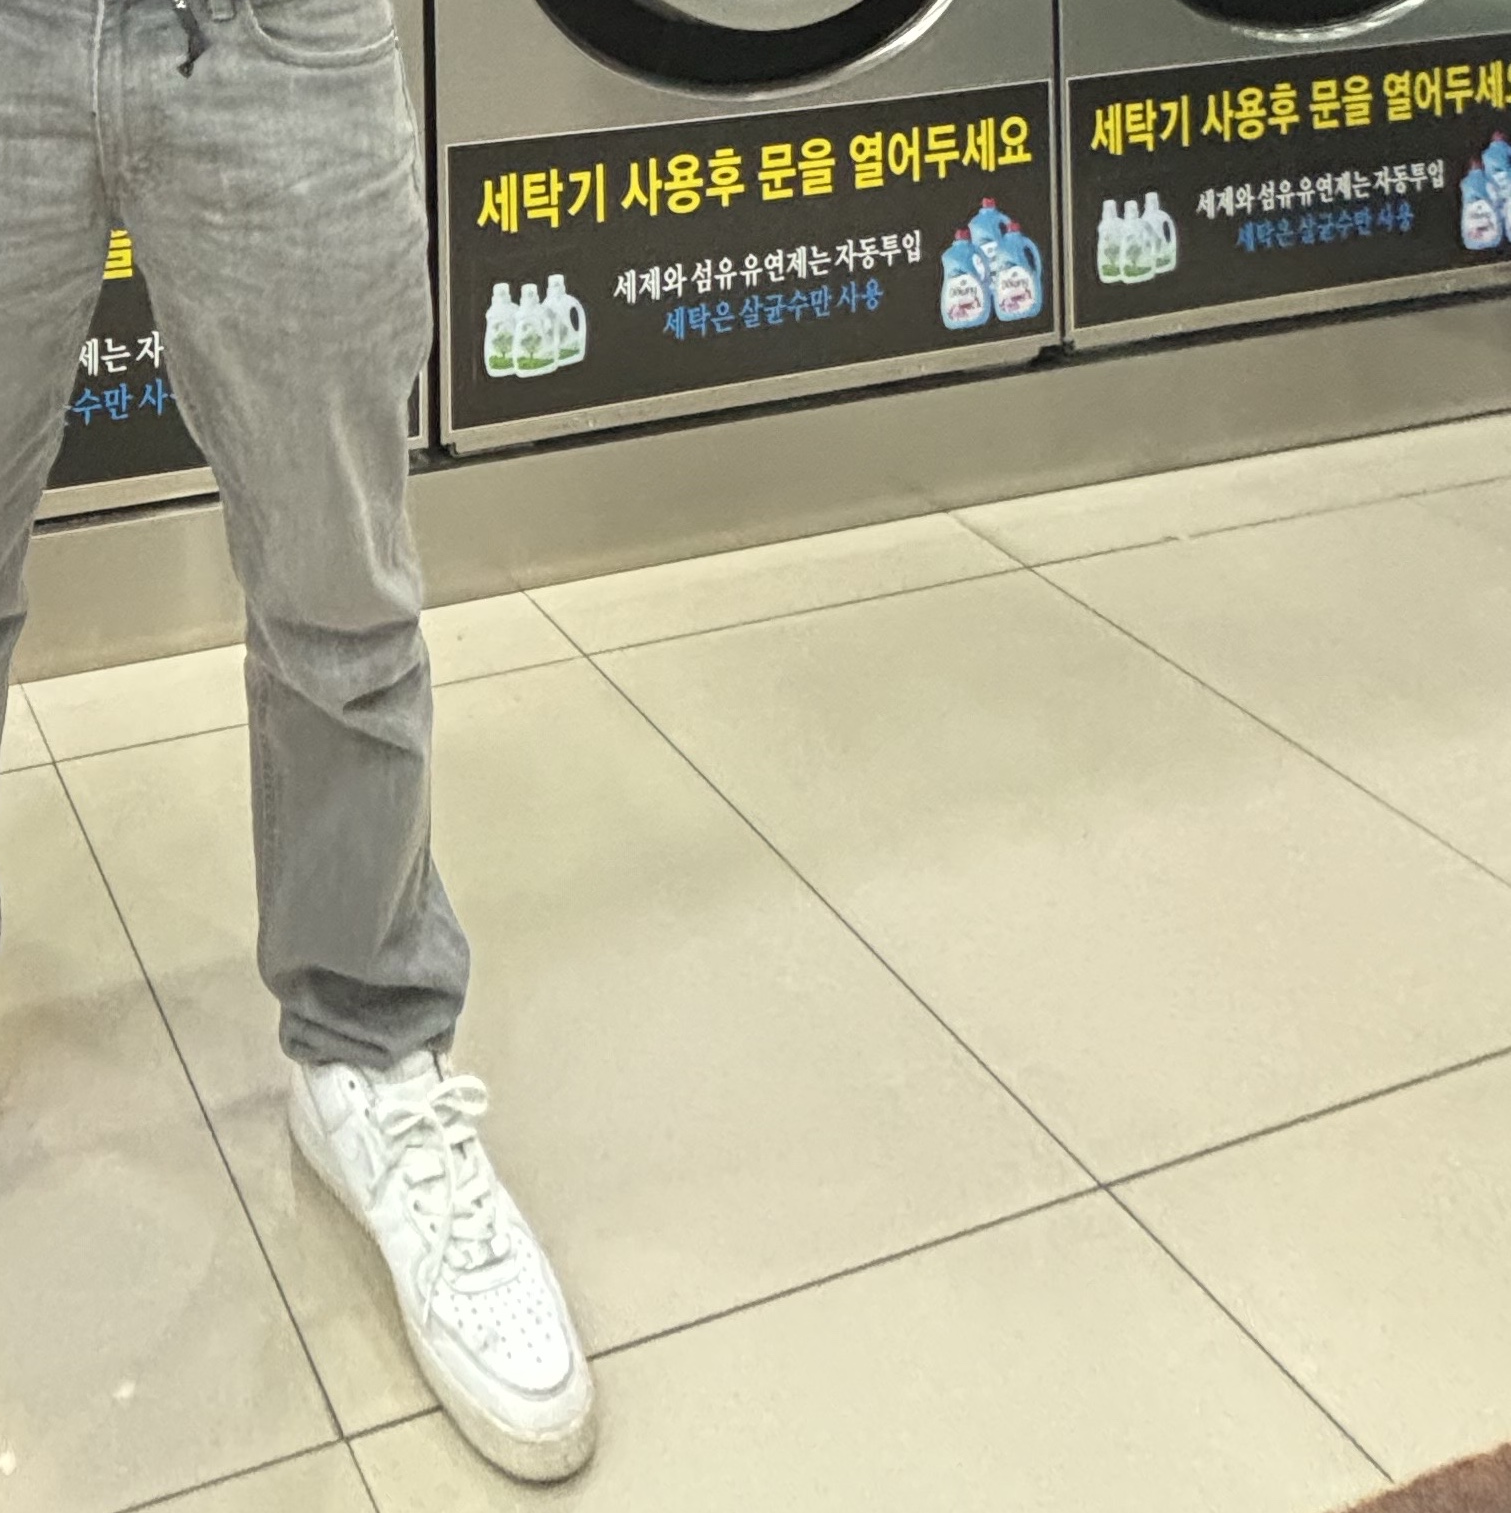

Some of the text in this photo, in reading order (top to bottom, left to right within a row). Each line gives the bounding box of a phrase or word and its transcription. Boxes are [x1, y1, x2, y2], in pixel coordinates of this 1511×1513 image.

[1091, 60, 1511, 156] 세탁기 사용후 문을 열어두세
[477, 114, 1032, 234] 세탁기 사용후 문을 열어두세요
[613, 229, 922, 304] 세제와 자동투입
[663, 277, 883, 341] 세탁은 살균수만 사용
